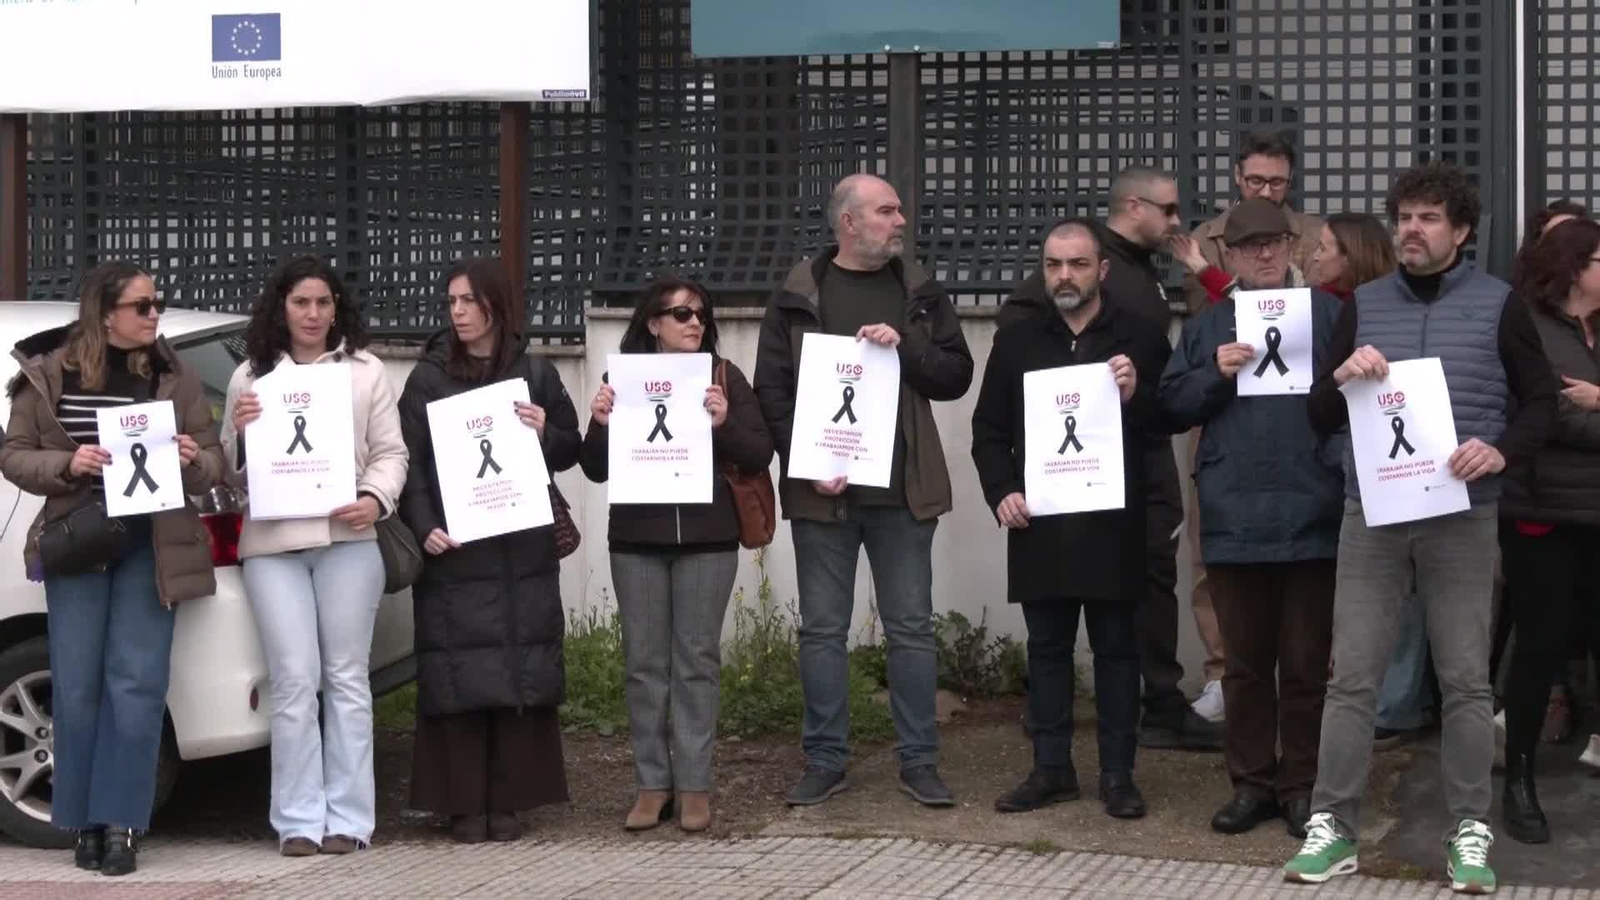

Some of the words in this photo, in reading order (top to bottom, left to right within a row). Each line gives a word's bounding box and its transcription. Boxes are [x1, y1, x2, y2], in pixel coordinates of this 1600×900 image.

[211, 64, 239, 79] Unión
[243, 64, 282, 81] Europea
[1258, 299, 1286, 311] USO
[836, 362, 864, 376] USO
[644, 381, 672, 392] USO
[283, 392, 311, 404] USO
[1056, 392, 1081, 406] USO
[1377, 391, 1406, 406] USO
[120, 413, 149, 428] USO
[466, 416, 494, 431] USO
[1414, 459, 1435, 468] PUEDE
